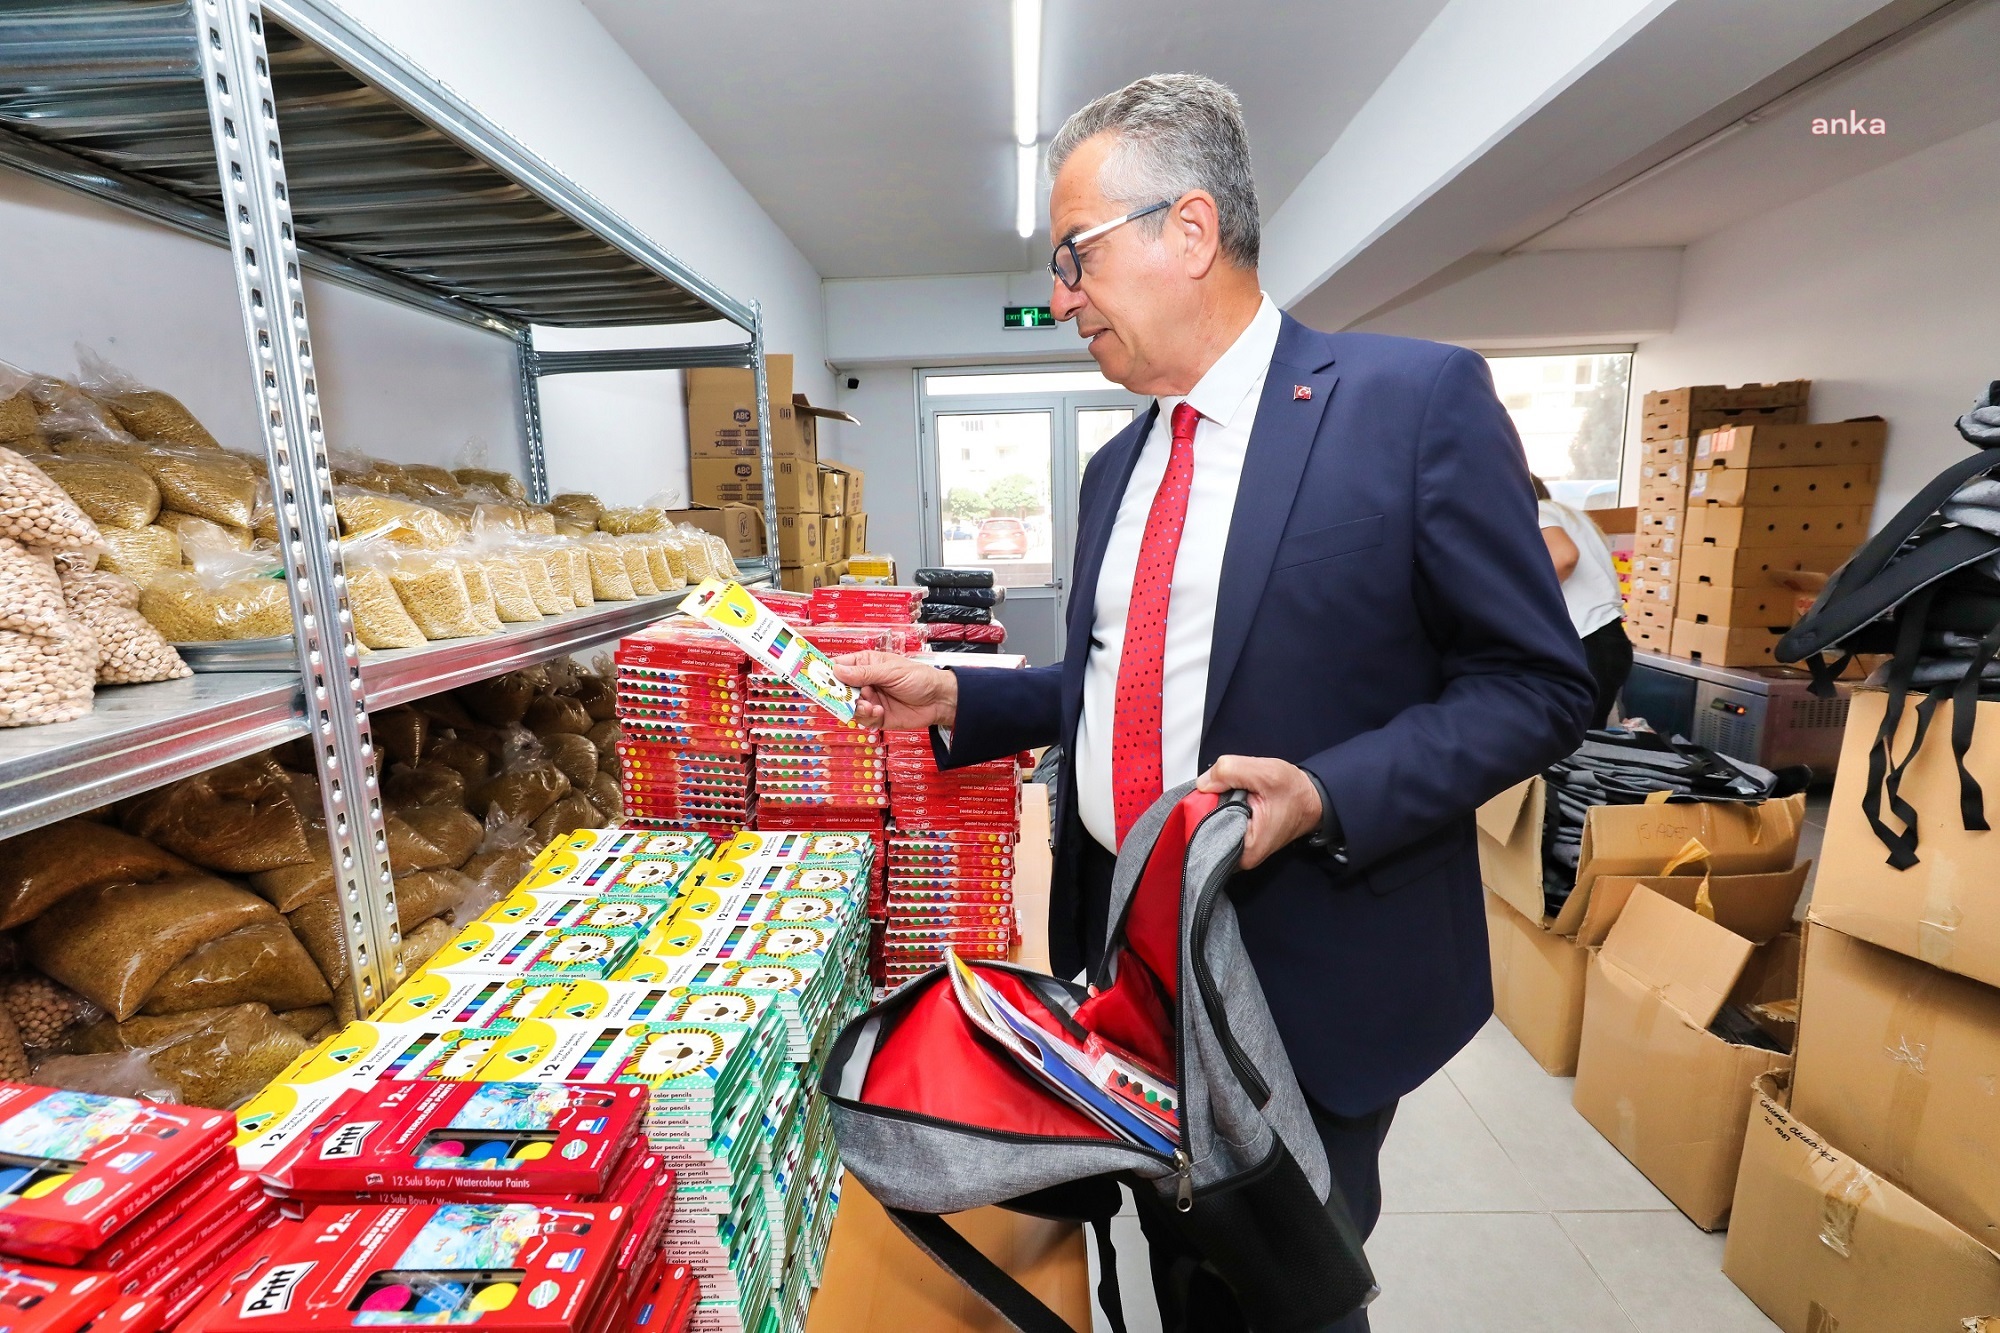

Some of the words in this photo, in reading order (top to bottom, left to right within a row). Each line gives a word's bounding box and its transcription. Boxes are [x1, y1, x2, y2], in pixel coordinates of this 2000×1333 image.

[751, 632, 763, 642] 12
[568, 875, 580, 884] 12
[741, 881, 752, 889] 12
[479, 952, 495, 962] 12
[696, 948, 710, 956] 12
[431, 1009, 450, 1019] 12
[529, 1044, 549, 1064] ADEL
[352, 1064, 375, 1077] 12
[538, 1064, 560, 1077] 12
[378, 1089, 406, 1108] 12
[258, 1111, 285, 1133] ADEL
[260, 1132, 287, 1149] 12
[324, 1124, 365, 1156] Pritt
[392, 1176, 404, 1186] 12
[405, 1176, 422, 1187] Sulu
[425, 1177, 446, 1188] Boya
[455, 1177, 503, 1188] Watercolour
[505, 1178, 530, 1188] Paints
[379, 1194, 389, 1203] 12
[390, 1194, 407, 1204] Sulu
[315, 1219, 350, 1243] 12
[247, 1270, 295, 1311] Pritt
